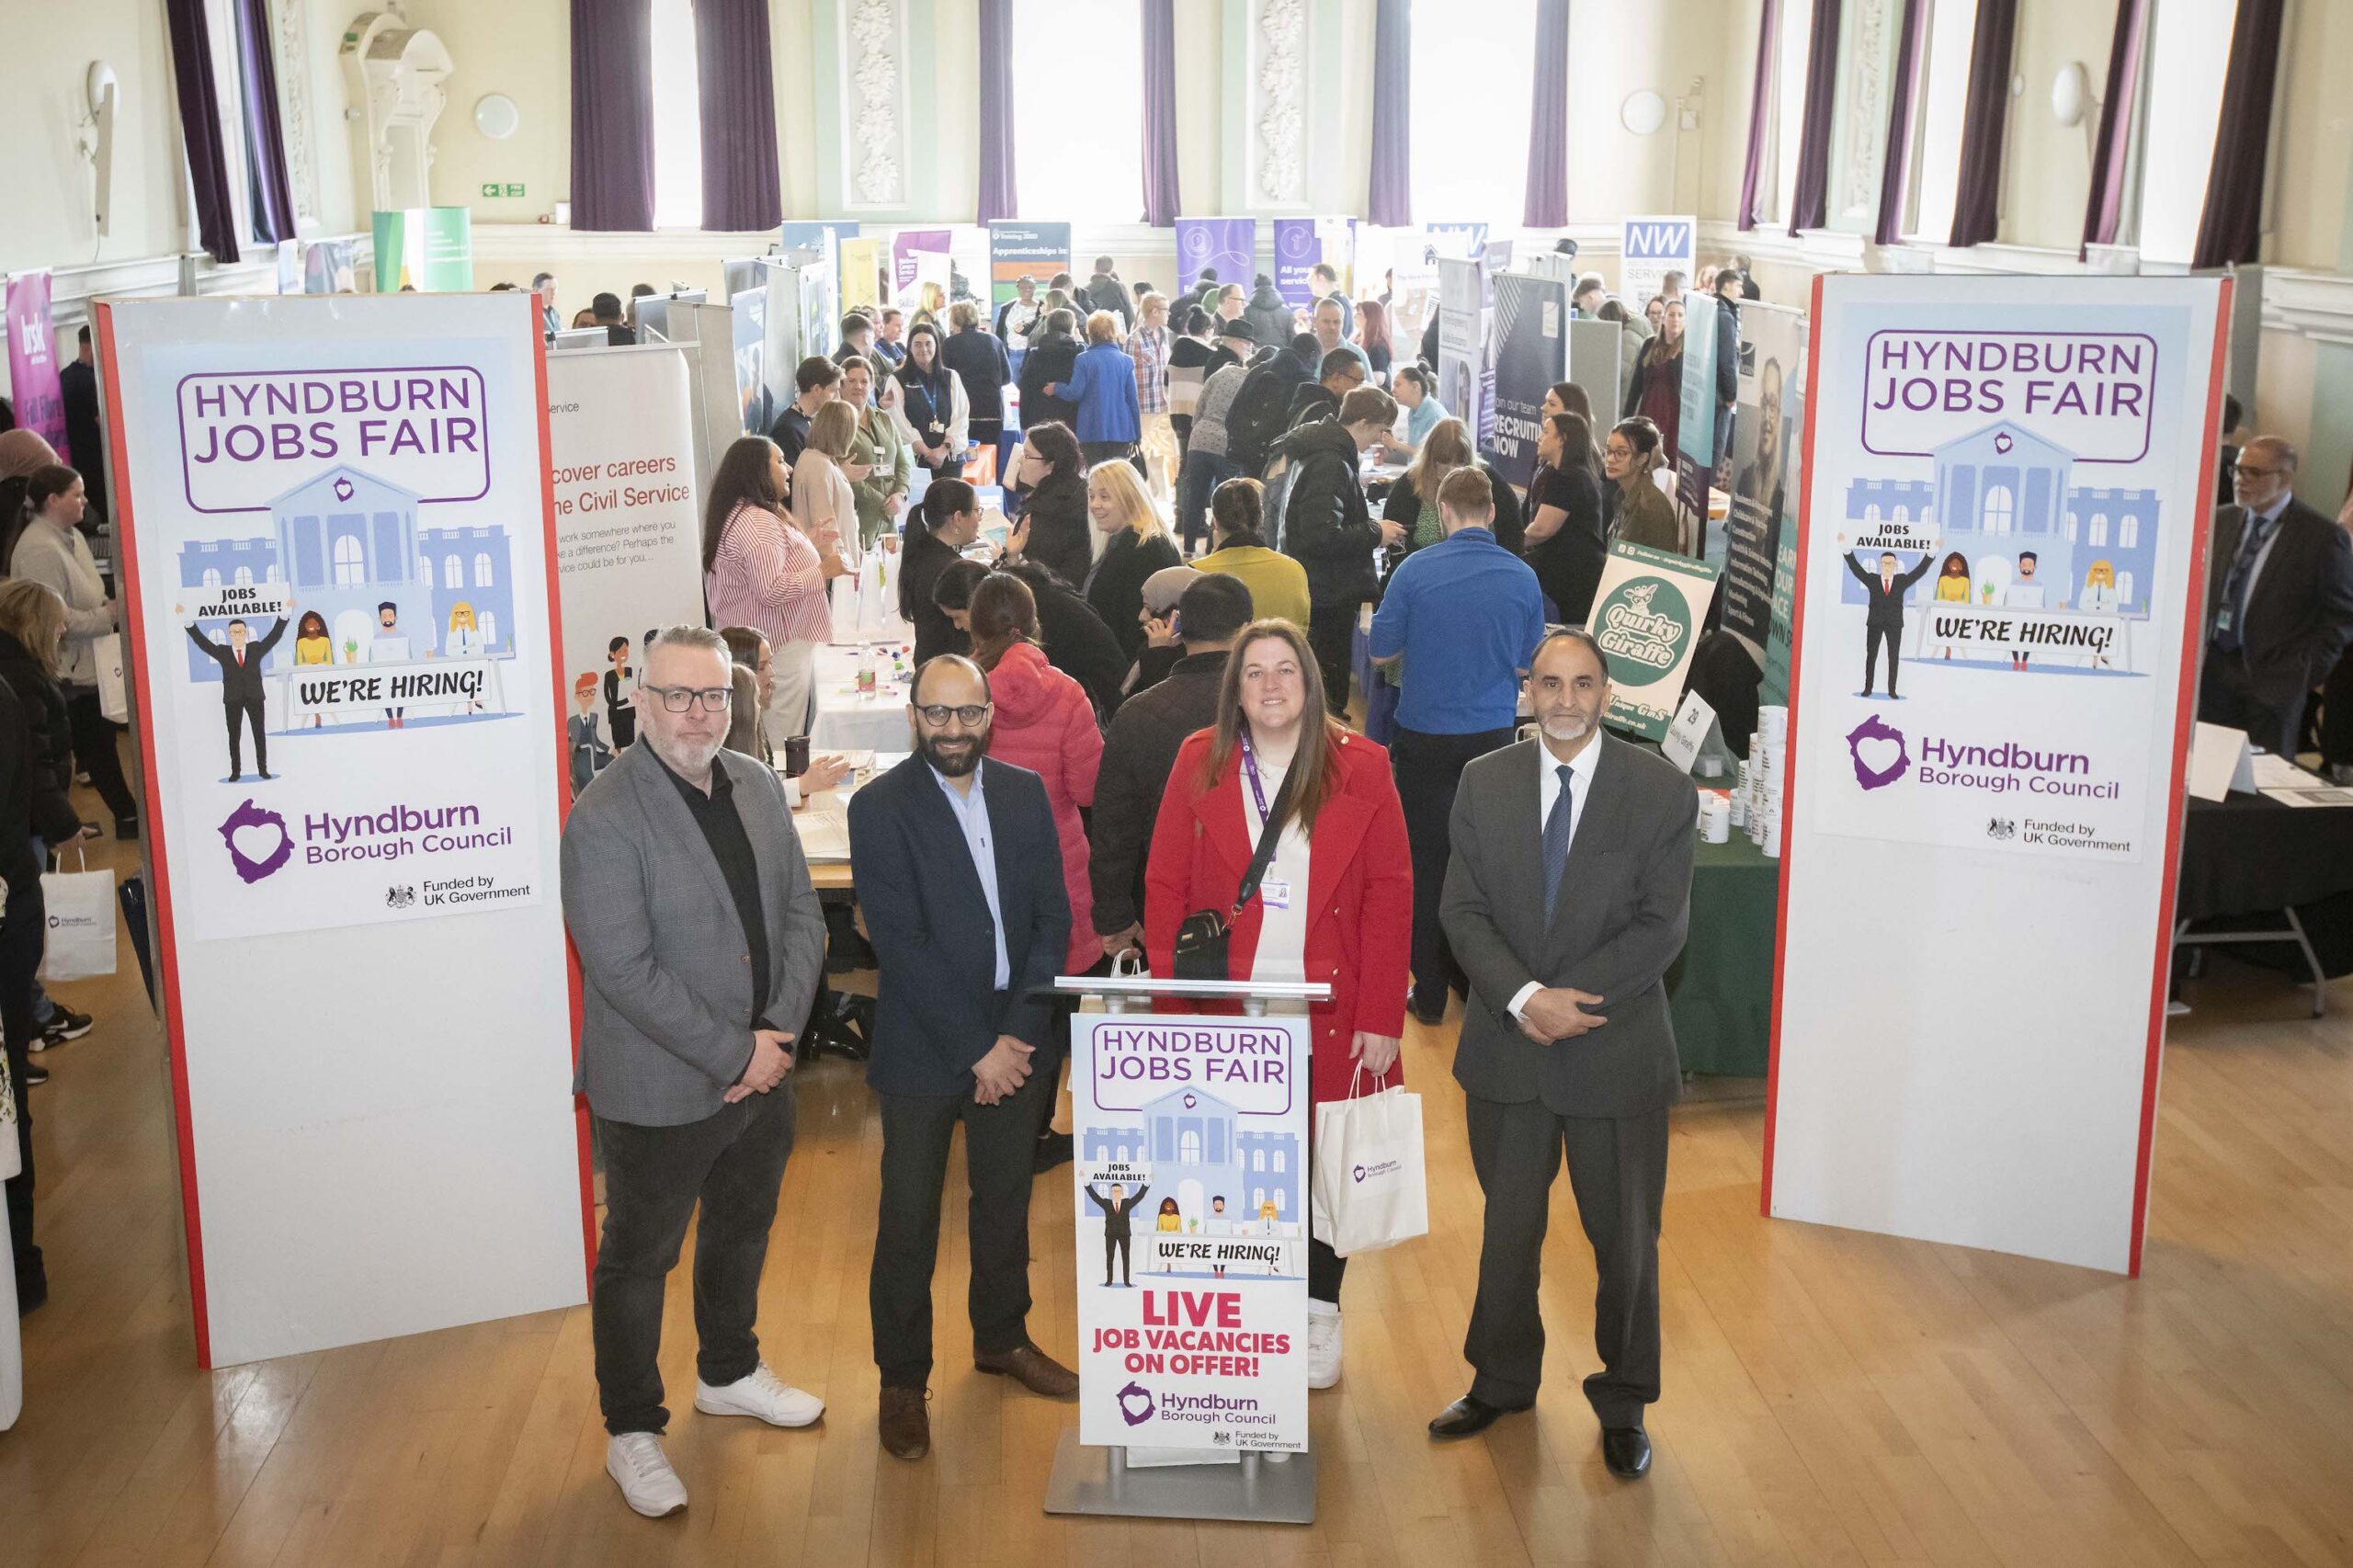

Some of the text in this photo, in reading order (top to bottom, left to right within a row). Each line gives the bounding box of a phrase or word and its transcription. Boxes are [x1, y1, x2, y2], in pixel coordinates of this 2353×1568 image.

[1628, 225, 1687, 255] NW
[993, 247, 1057, 256] Apprenticeships
[1279, 266, 1292, 274] All
[1881, 340, 2141, 374] HYNDBURN
[195, 378, 470, 417] HYNDBURN
[1873, 378, 2143, 416] JOBS FAIR
[1507, 401, 1518, 411] our
[1520, 402, 1536, 415] team
[194, 417, 478, 463] JOBS FAIR
[1494, 435, 1518, 458] NOW
[607, 457, 676, 478] careers
[579, 489, 617, 512] Civil
[624, 483, 689, 506] Service
[559, 522, 676, 543] work somewhere where you
[1879, 525, 1910, 536] JOBS
[576, 540, 620, 556] difference?
[623, 539, 657, 549] Perhaps
[661, 535, 674, 544] the
[1857, 537, 1930, 550] AVAILABLE!
[578, 559, 600, 571] could
[603, 558, 614, 567] be
[617, 555, 626, 565] for
[222, 588, 256, 603] JOBS
[199, 600, 282, 617] AVAILABLE!
[1608, 606, 1681, 642] Quirky
[1936, 617, 2112, 653] WE'RE HIRING!
[1600, 631, 1673, 666] Giraffe
[301, 670, 483, 706] WE'RE HIRING!
[1688, 708, 1699, 724] 29
[1922, 737, 2089, 774] Hyndburn
[1919, 767, 2120, 799] Borough Council
[304, 804, 480, 845] Hyndburn
[2024, 819, 2095, 837] Funded by
[306, 827, 512, 865] Borough Council
[2023, 833, 2131, 852] UK Government
[424, 876, 494, 892] Funded by
[424, 884, 529, 906] UK Government
[1104, 1030, 1280, 1055] HYNDBURN
[1100, 1056, 1284, 1084] JOBS FAIR
[1093, 1173, 1146, 1181] AVAILABLE!
[1108, 1164, 1130, 1172] JOBS
[1367, 1160, 1397, 1173] Hyndburn
[1159, 1243, 1280, 1265] WE'RE HIRING!
[1142, 1290, 1242, 1328] LIVE
[1093, 1328, 1290, 1355] JOB VACANCIES
[1124, 1353, 1260, 1378] ON OFFER!
[1161, 1392, 1257, 1411] Hyndburn
[1161, 1410, 1276, 1425] Borough Council
[1235, 1431, 1279, 1441] Funded by
[1250, 1439, 1302, 1449] Government
